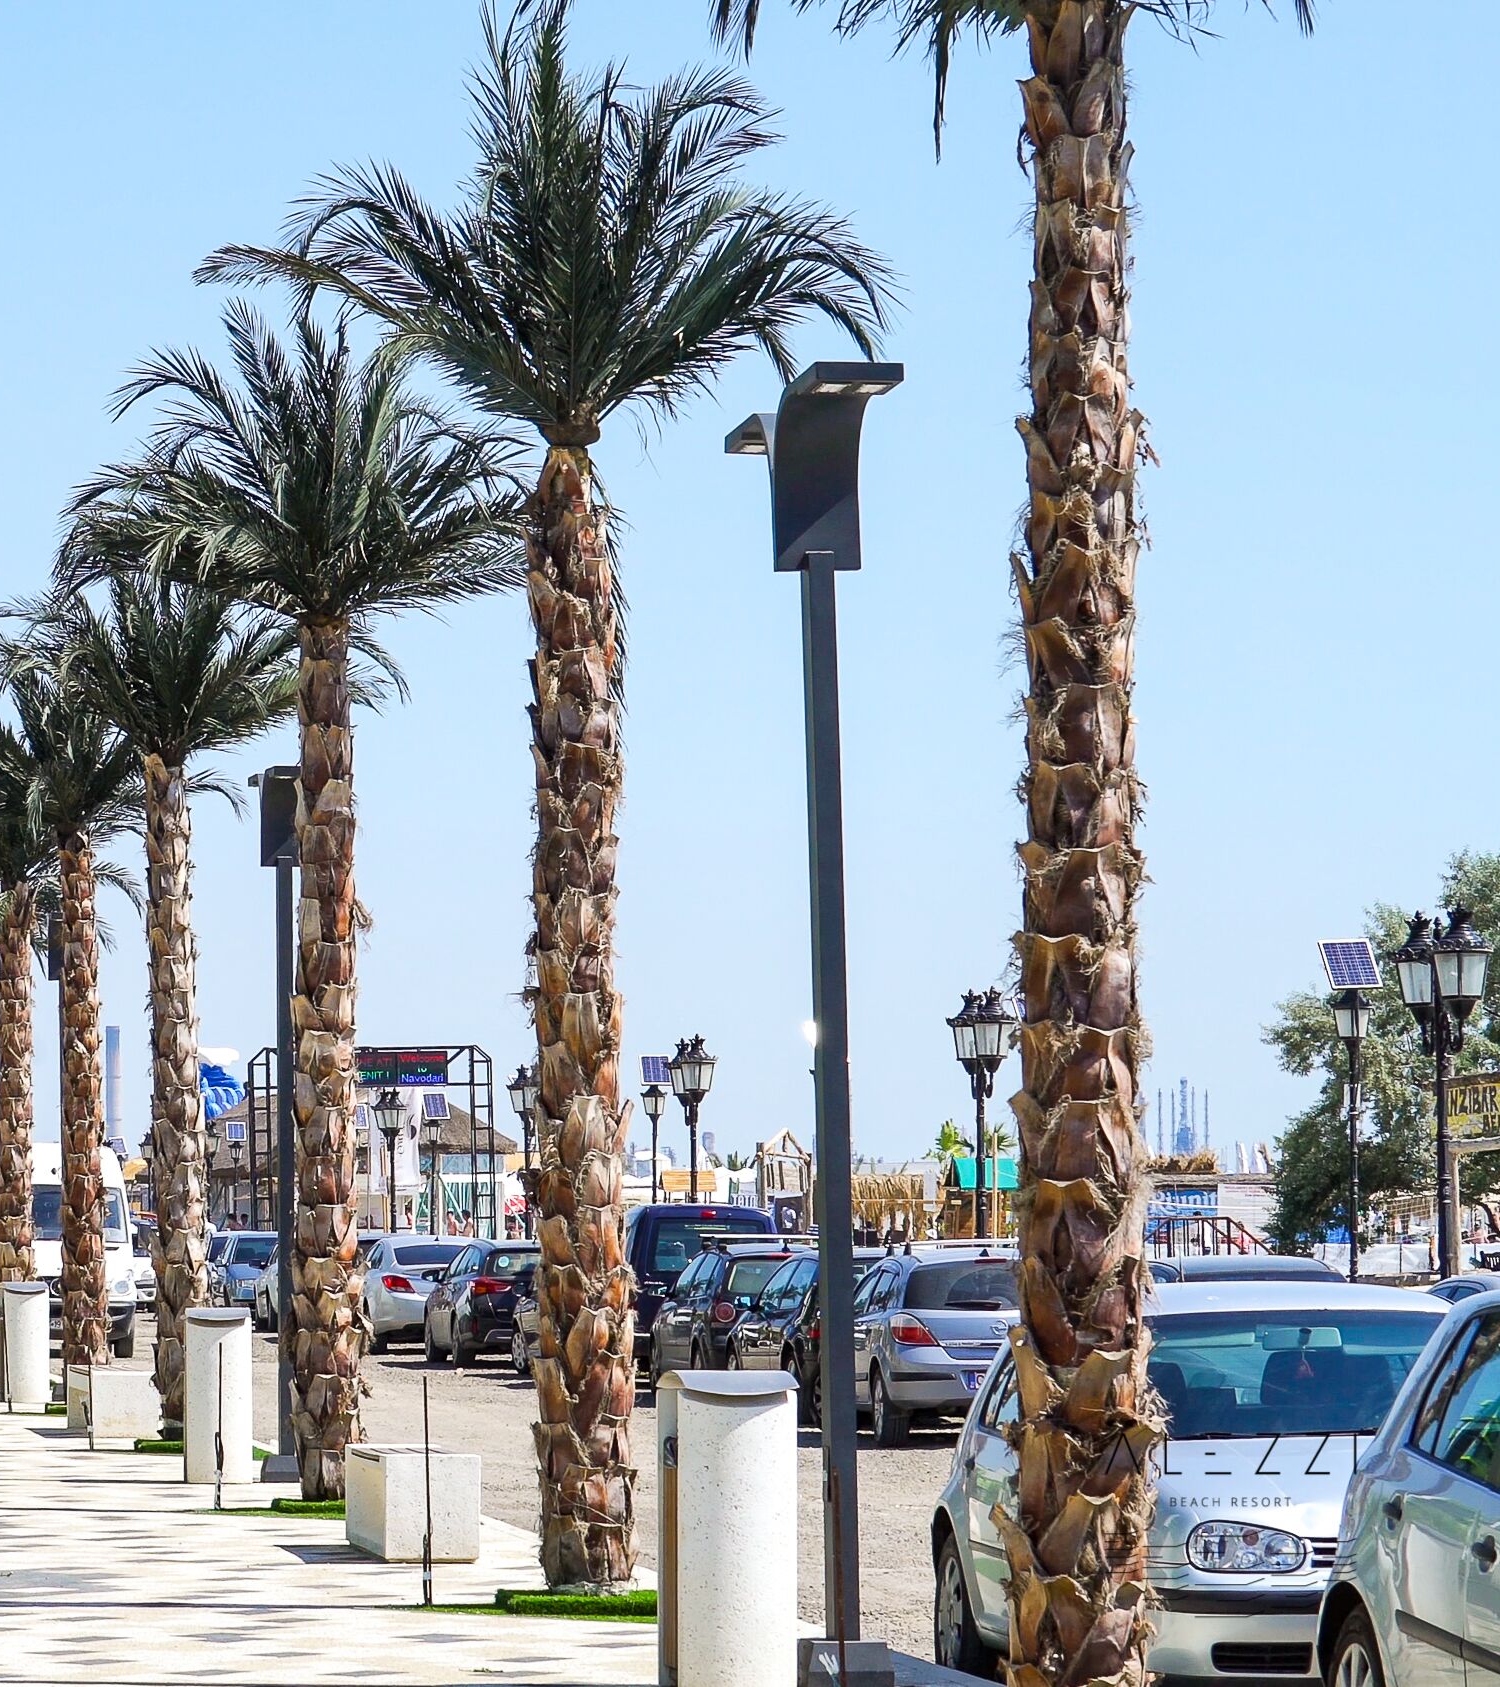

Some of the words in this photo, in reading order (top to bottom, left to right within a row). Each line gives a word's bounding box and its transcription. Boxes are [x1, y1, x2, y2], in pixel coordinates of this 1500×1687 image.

[400, 1055, 445, 1064] Welcome
[359, 1071, 384, 1081] ENIT
[401, 1073, 444, 1083] Navodari
[1448, 1086, 1499, 1117] NZIBAR
